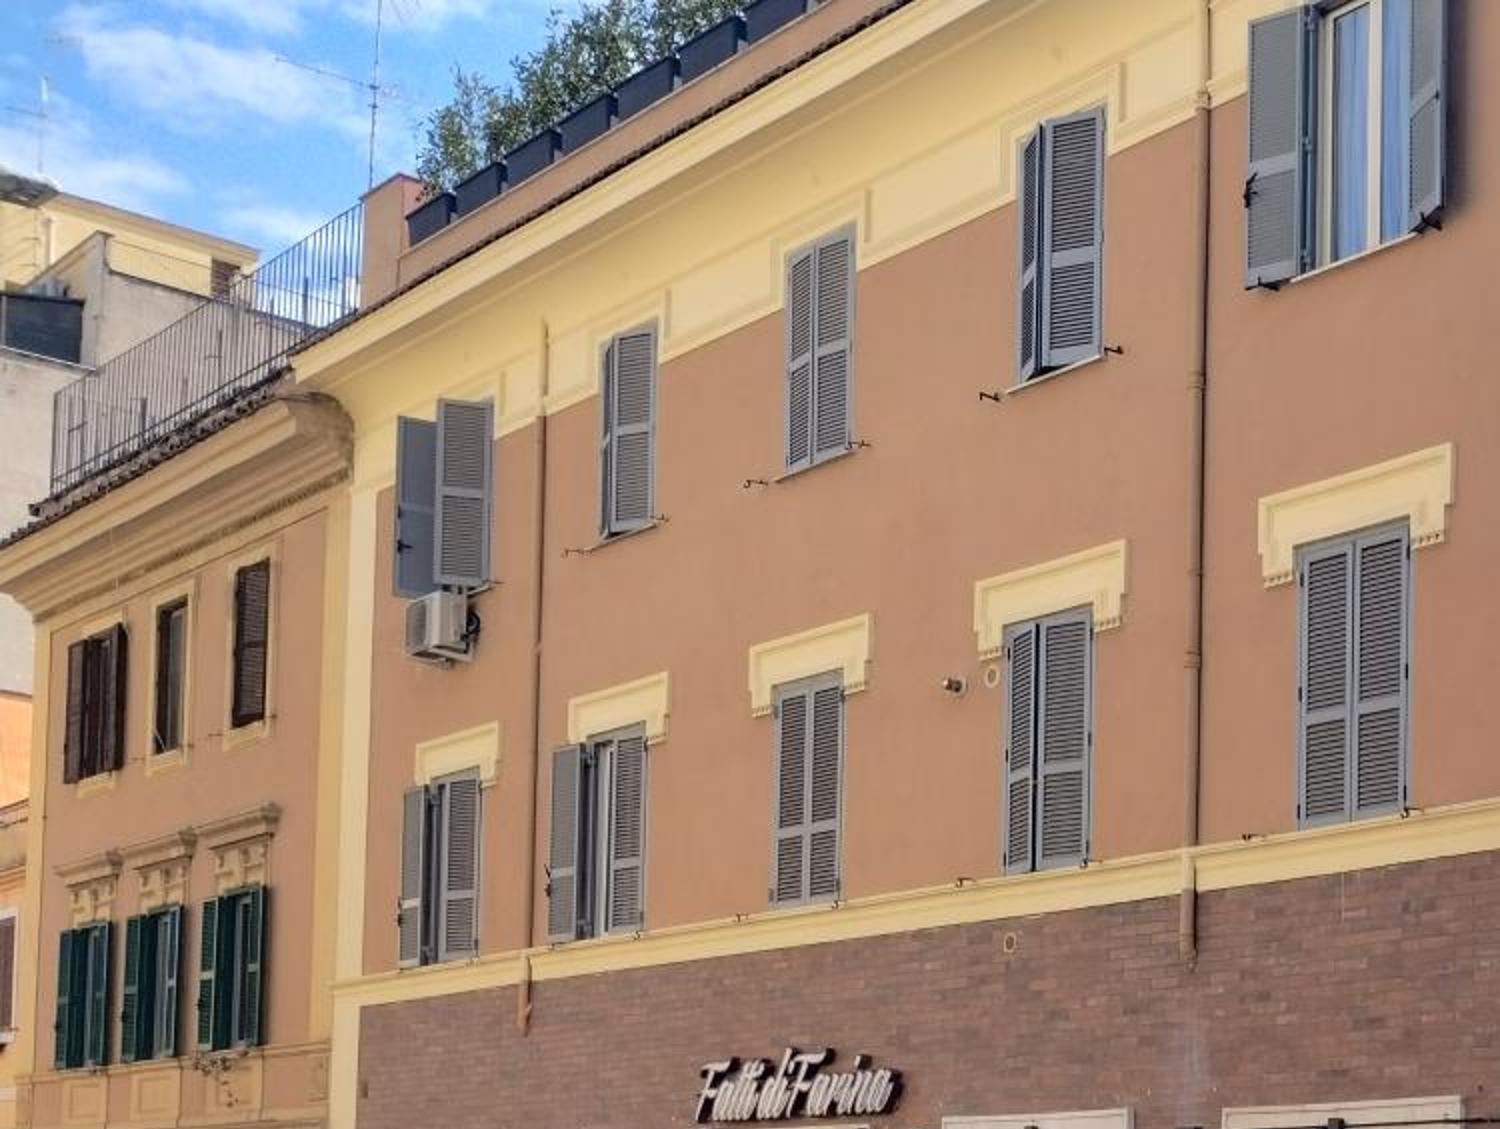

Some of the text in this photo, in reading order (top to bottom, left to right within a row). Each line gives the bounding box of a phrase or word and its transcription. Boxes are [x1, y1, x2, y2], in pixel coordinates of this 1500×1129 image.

[695, 1047, 893, 1121] Fatti di Farina
